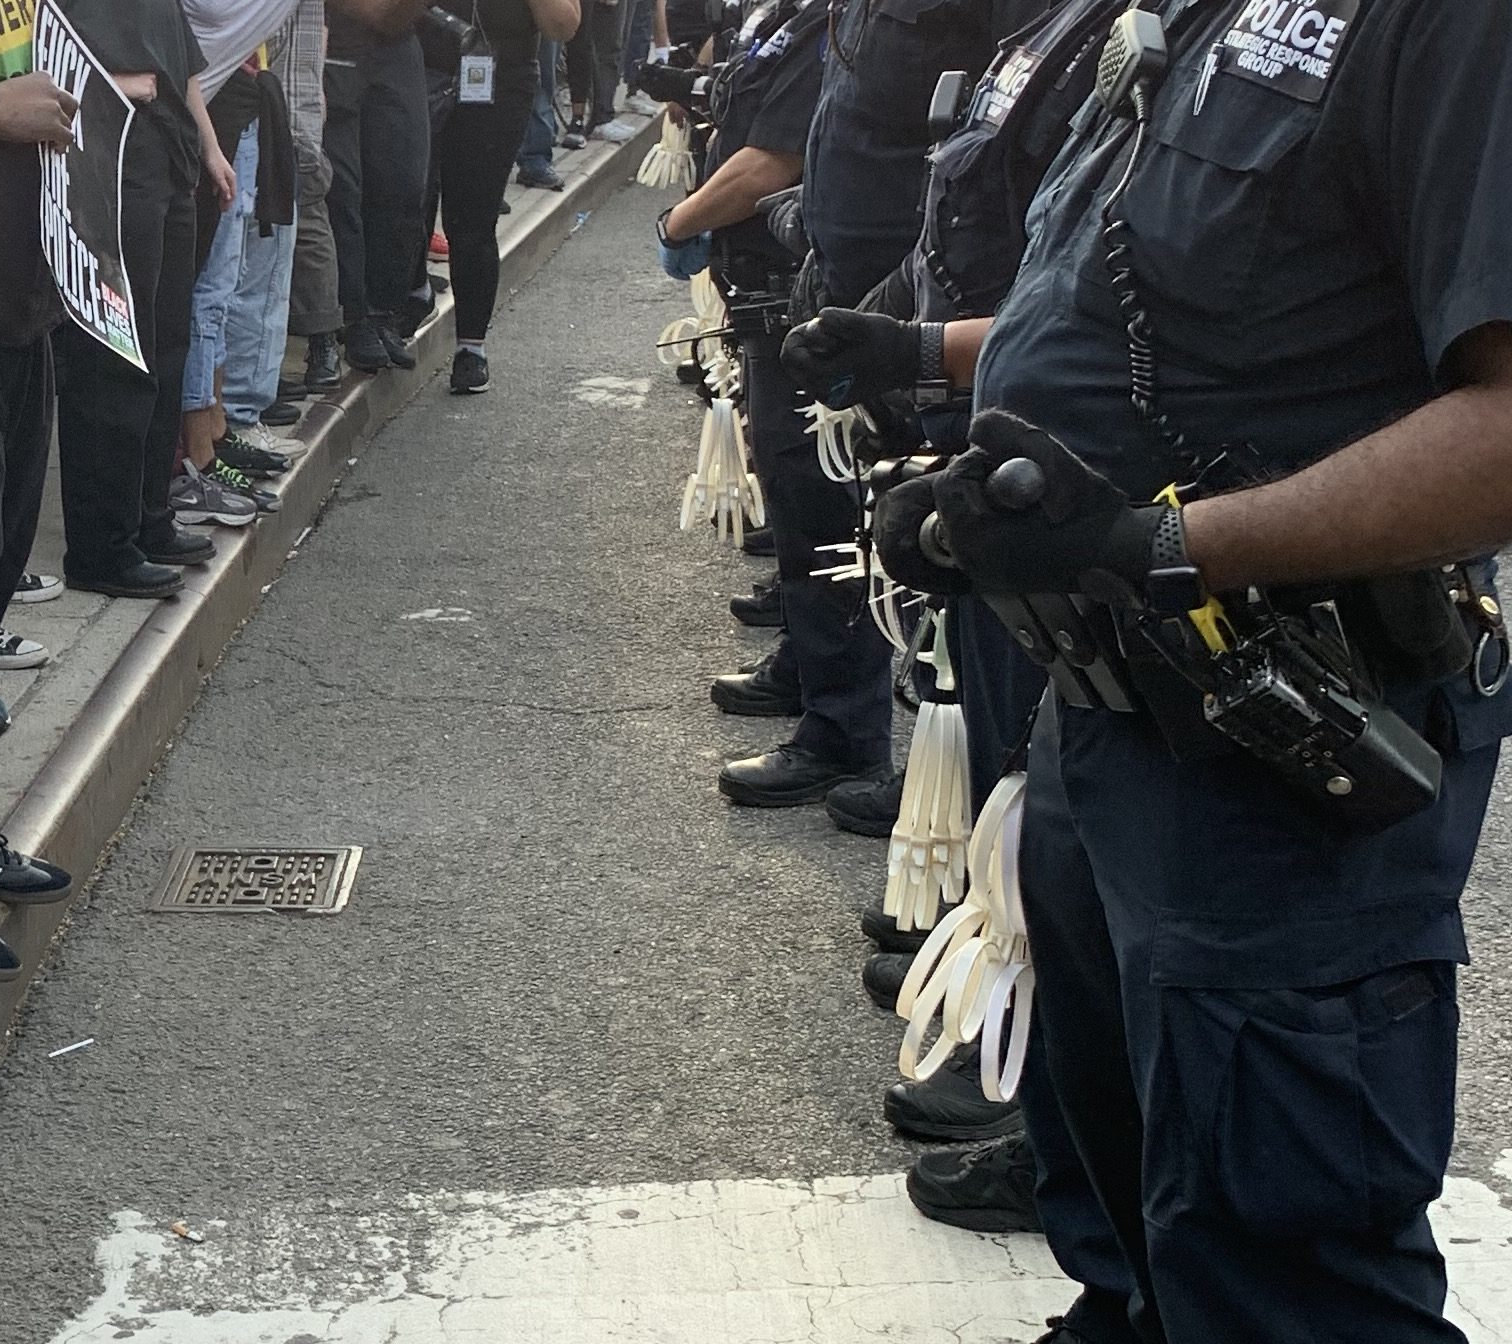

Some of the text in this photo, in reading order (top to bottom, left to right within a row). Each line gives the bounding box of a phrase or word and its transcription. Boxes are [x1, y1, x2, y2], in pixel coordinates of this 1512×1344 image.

[1224, 29, 1331, 79] STRATEGIC RESPONSE
[1237, 51, 1284, 78] GROUP
[45, 183, 107, 335] POLICE
